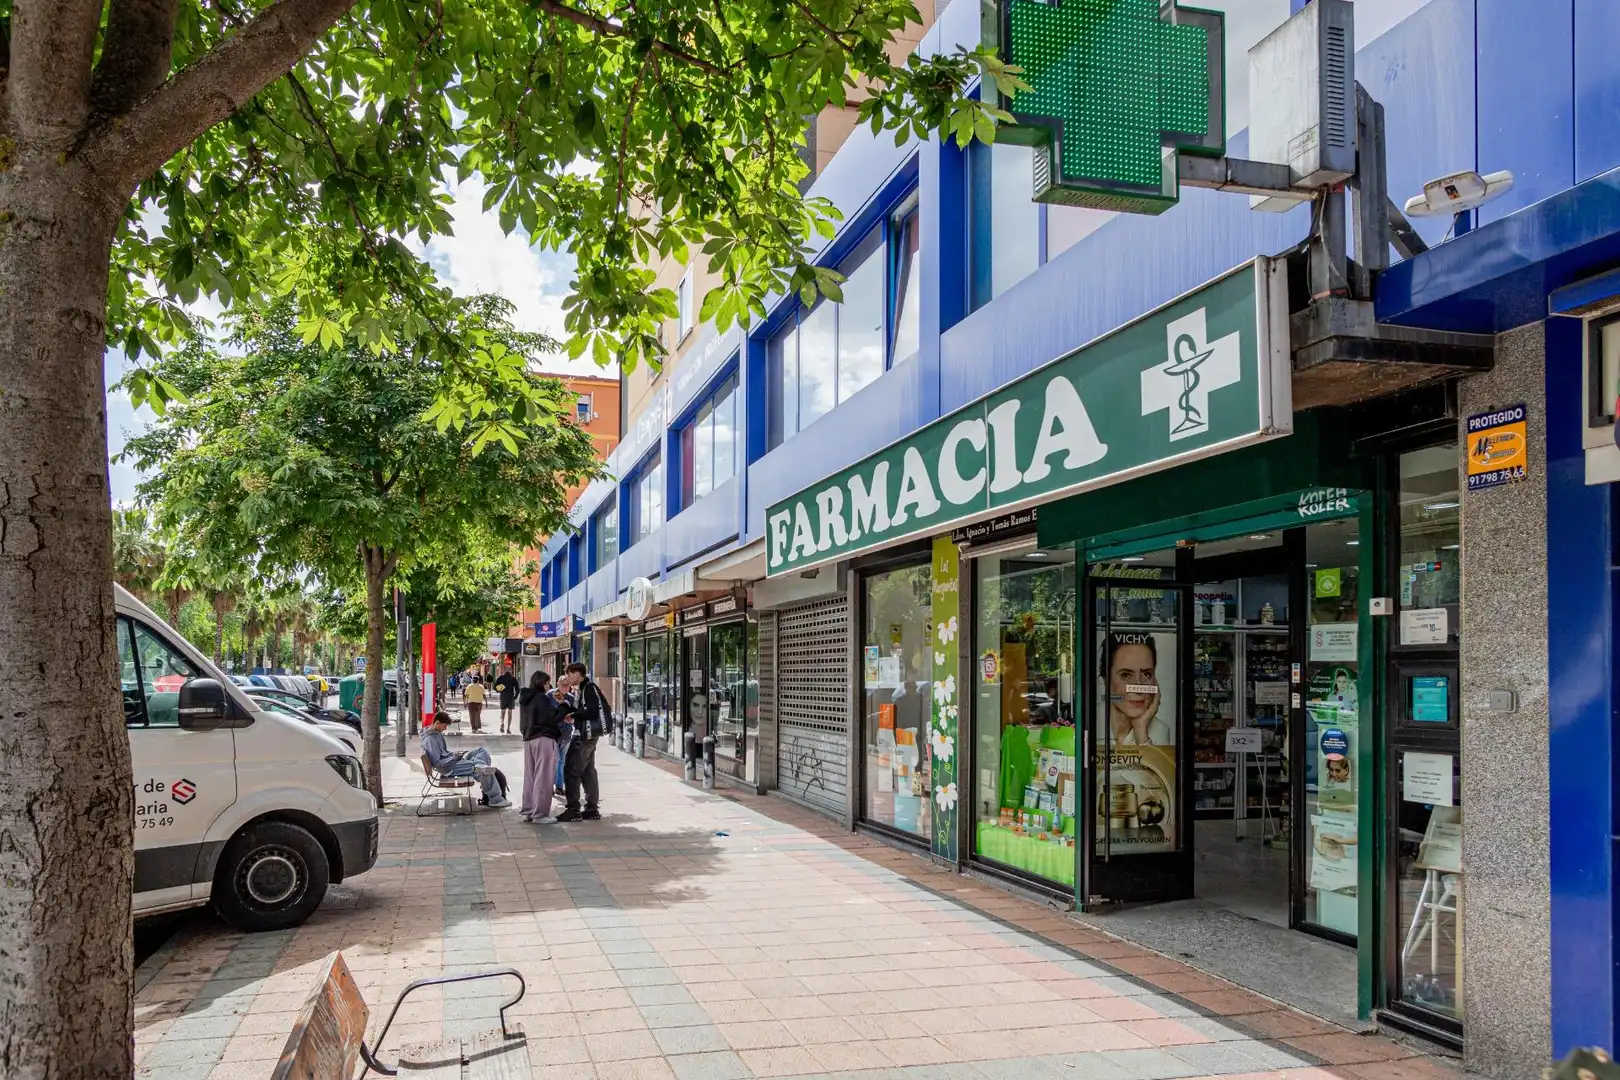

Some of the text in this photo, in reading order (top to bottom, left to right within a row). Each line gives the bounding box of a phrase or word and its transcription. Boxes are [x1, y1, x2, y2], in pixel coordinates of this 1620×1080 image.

[1469, 408, 1523, 430] PROTEGIDO
[768, 375, 1108, 568] FARMACIA
[1499, 470, 1512, 480] 75
[1297, 497, 1351, 518] KOLER
[966, 525, 986, 541] Ignacio
[986, 526, 991, 535] y
[990, 519, 1010, 532] Tomás
[1010, 514, 1031, 527] Ramos
[1114, 634, 1149, 645] VICHY
[1128, 685, 1156, 693] cerrado
[1092, 755, 1143, 764] ONGEVITY
[143, 778, 165, 794] de
[136, 801, 168, 816] aria
[141, 819, 156, 829] 75
[159, 816, 174, 828] 49
